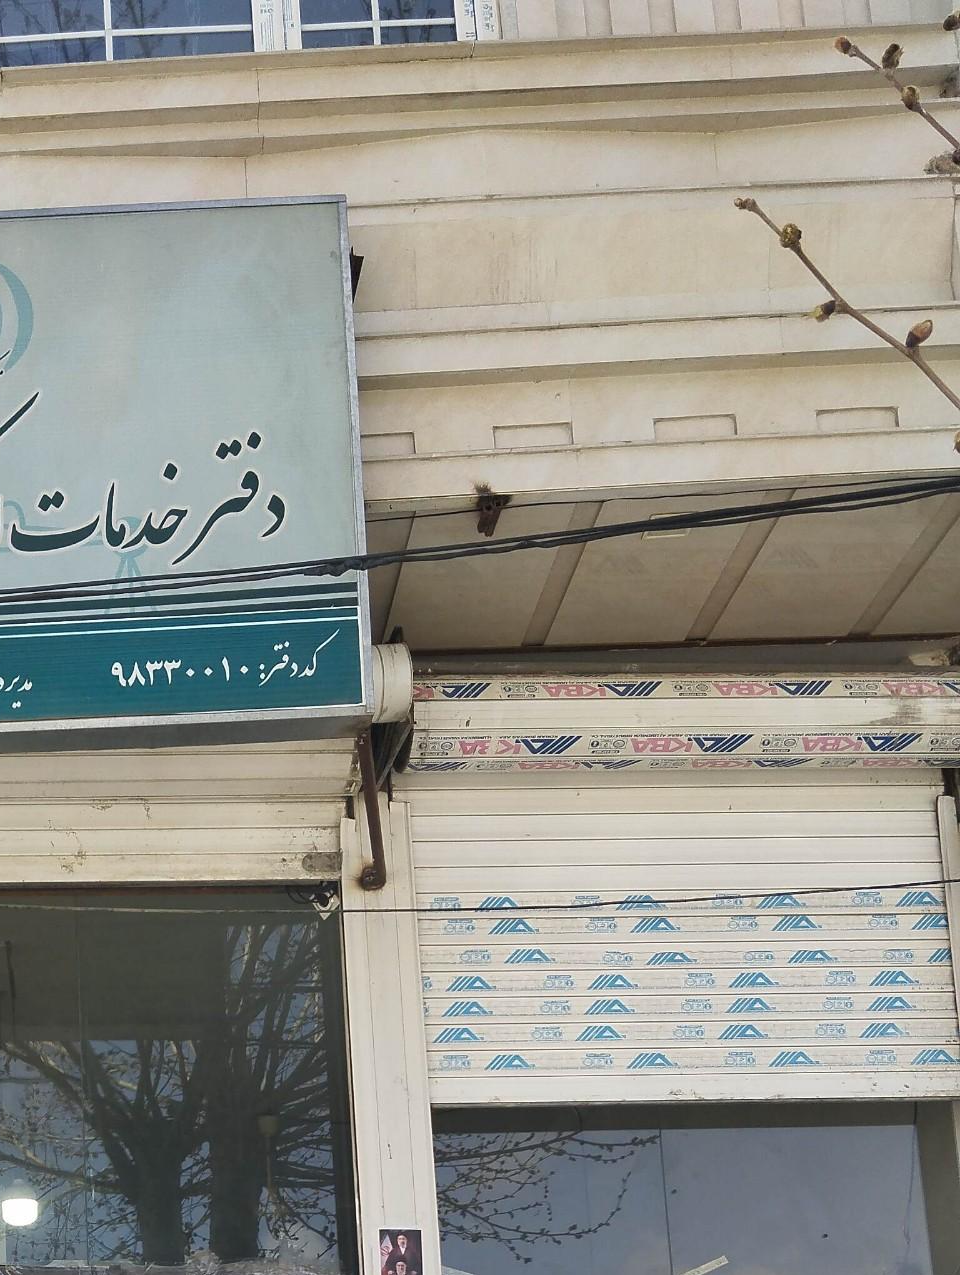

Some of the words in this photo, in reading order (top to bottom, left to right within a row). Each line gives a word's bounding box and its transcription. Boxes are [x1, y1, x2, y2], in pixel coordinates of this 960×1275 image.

[10, 461, 189, 553] خدمات
[171, 430, 286, 566] دفتر
[258, 640, 301, 686] دفتر:
[302, 628, 340, 679] کد
[5, 676, 33, 709] مدیر
[541, 684, 608, 697] KBA
[713, 683, 778, 696] KBA
[883, 682, 946, 695] KBA
[630, 737, 693, 753] KBA
[801, 736, 863, 752] KBA
